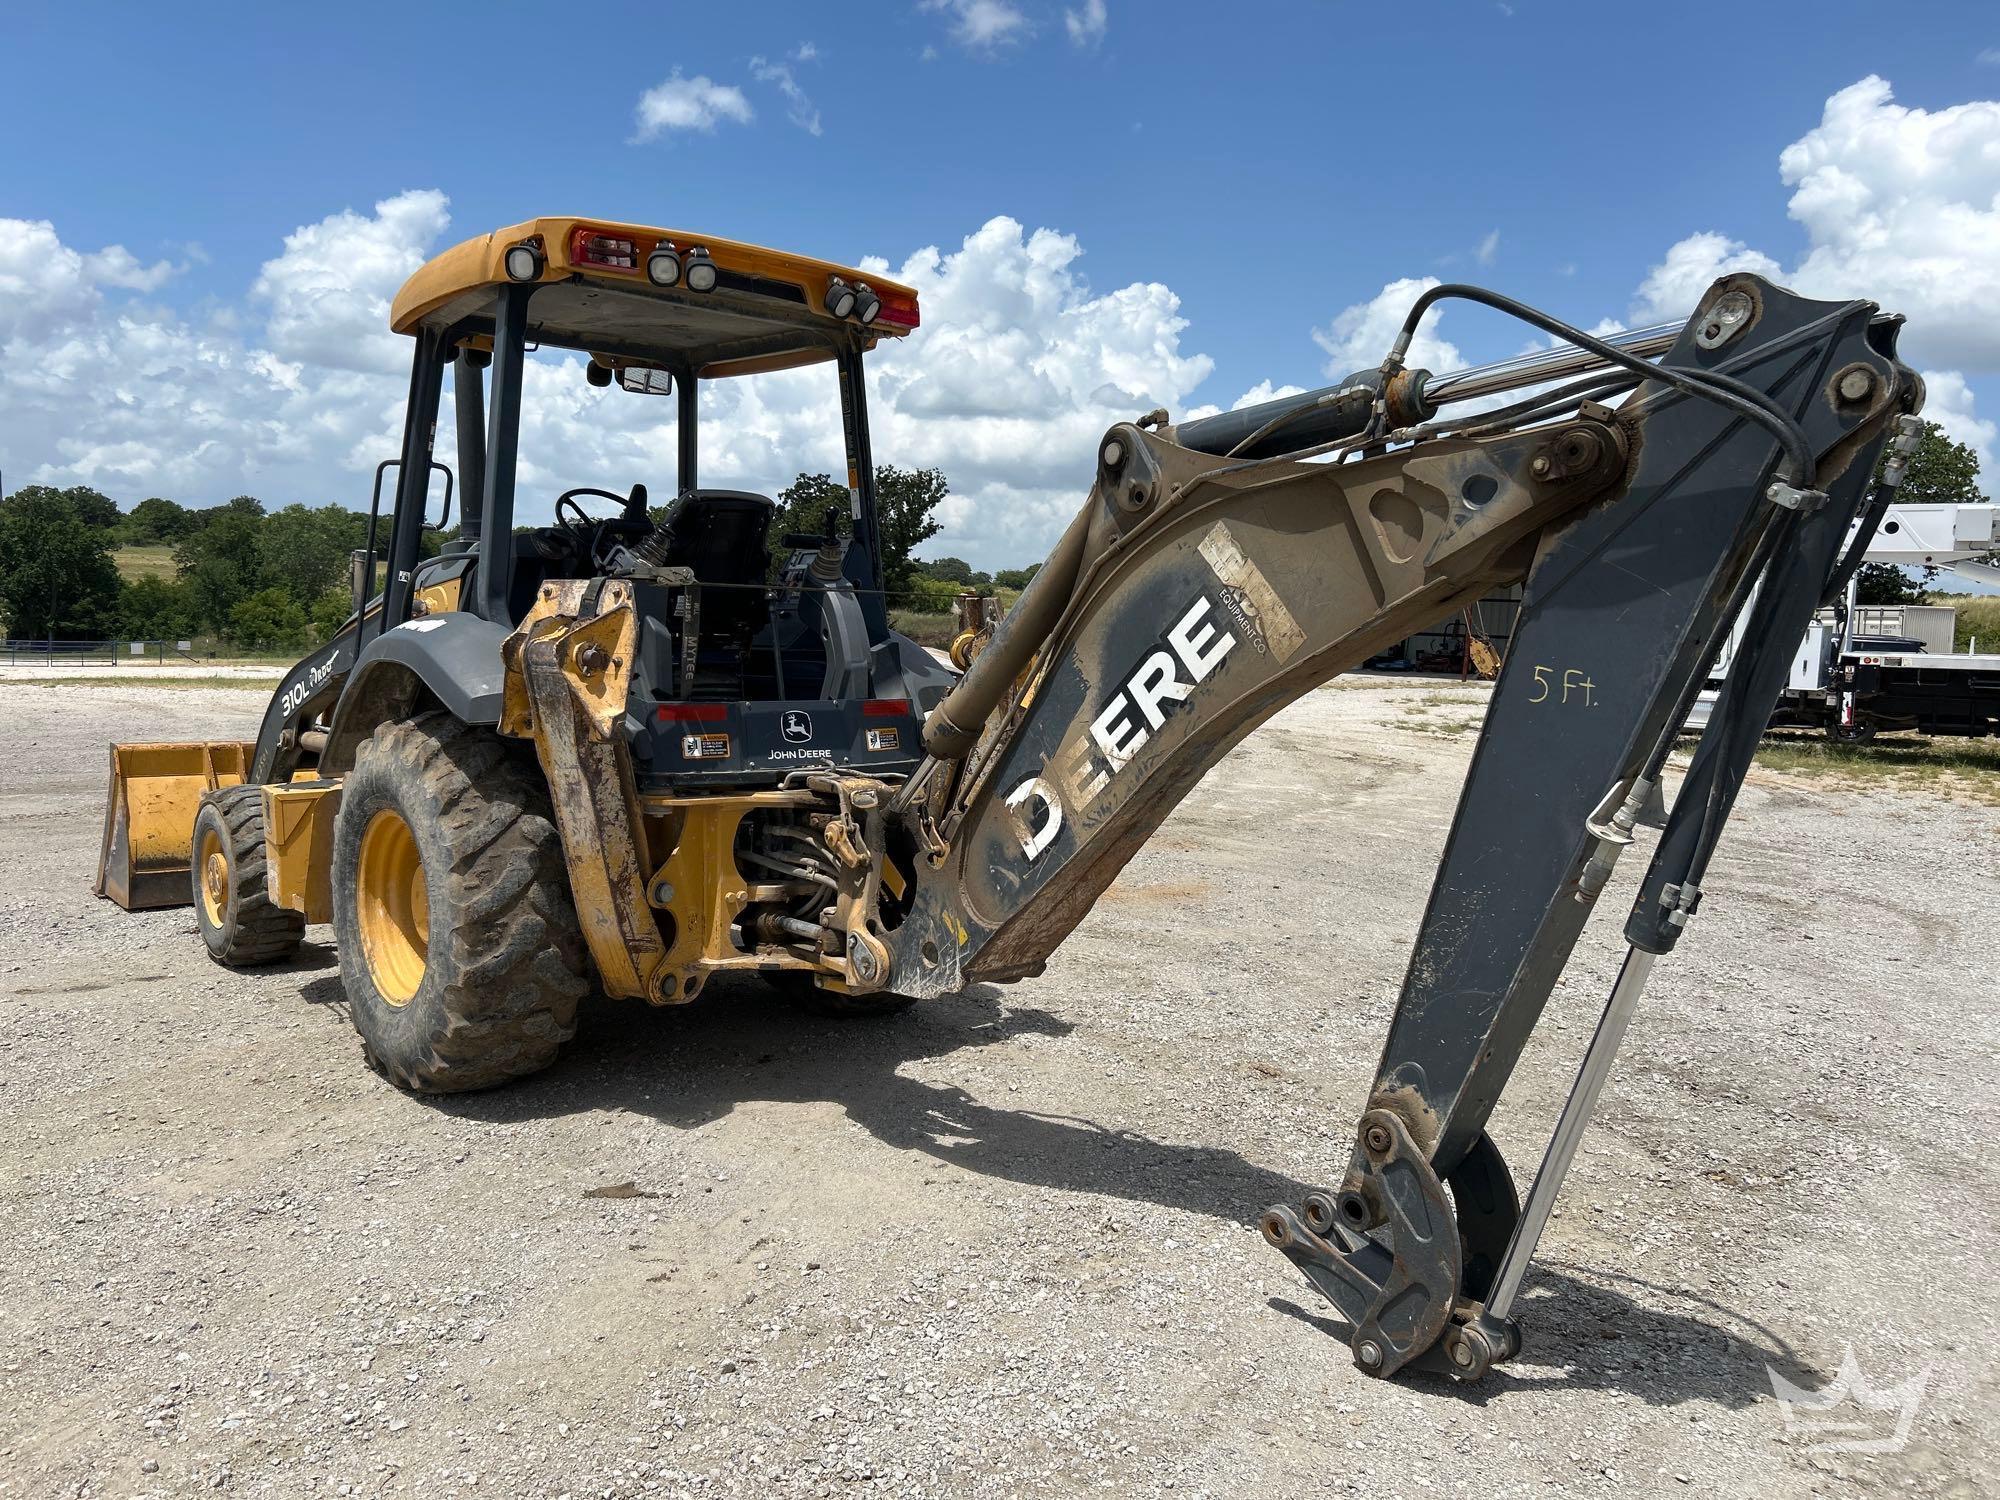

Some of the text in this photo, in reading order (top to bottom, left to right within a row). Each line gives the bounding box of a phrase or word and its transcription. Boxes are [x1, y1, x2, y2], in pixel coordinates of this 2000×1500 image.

[1219, 589, 1257, 639] EQUIPMENT
[685, 636, 698, 680] MYTEE
[281, 680, 310, 716] 310L
[1528, 665, 1554, 703] 5
[1004, 595, 1237, 863] DEERE
[768, 748, 832, 760] JOHN DEERE
